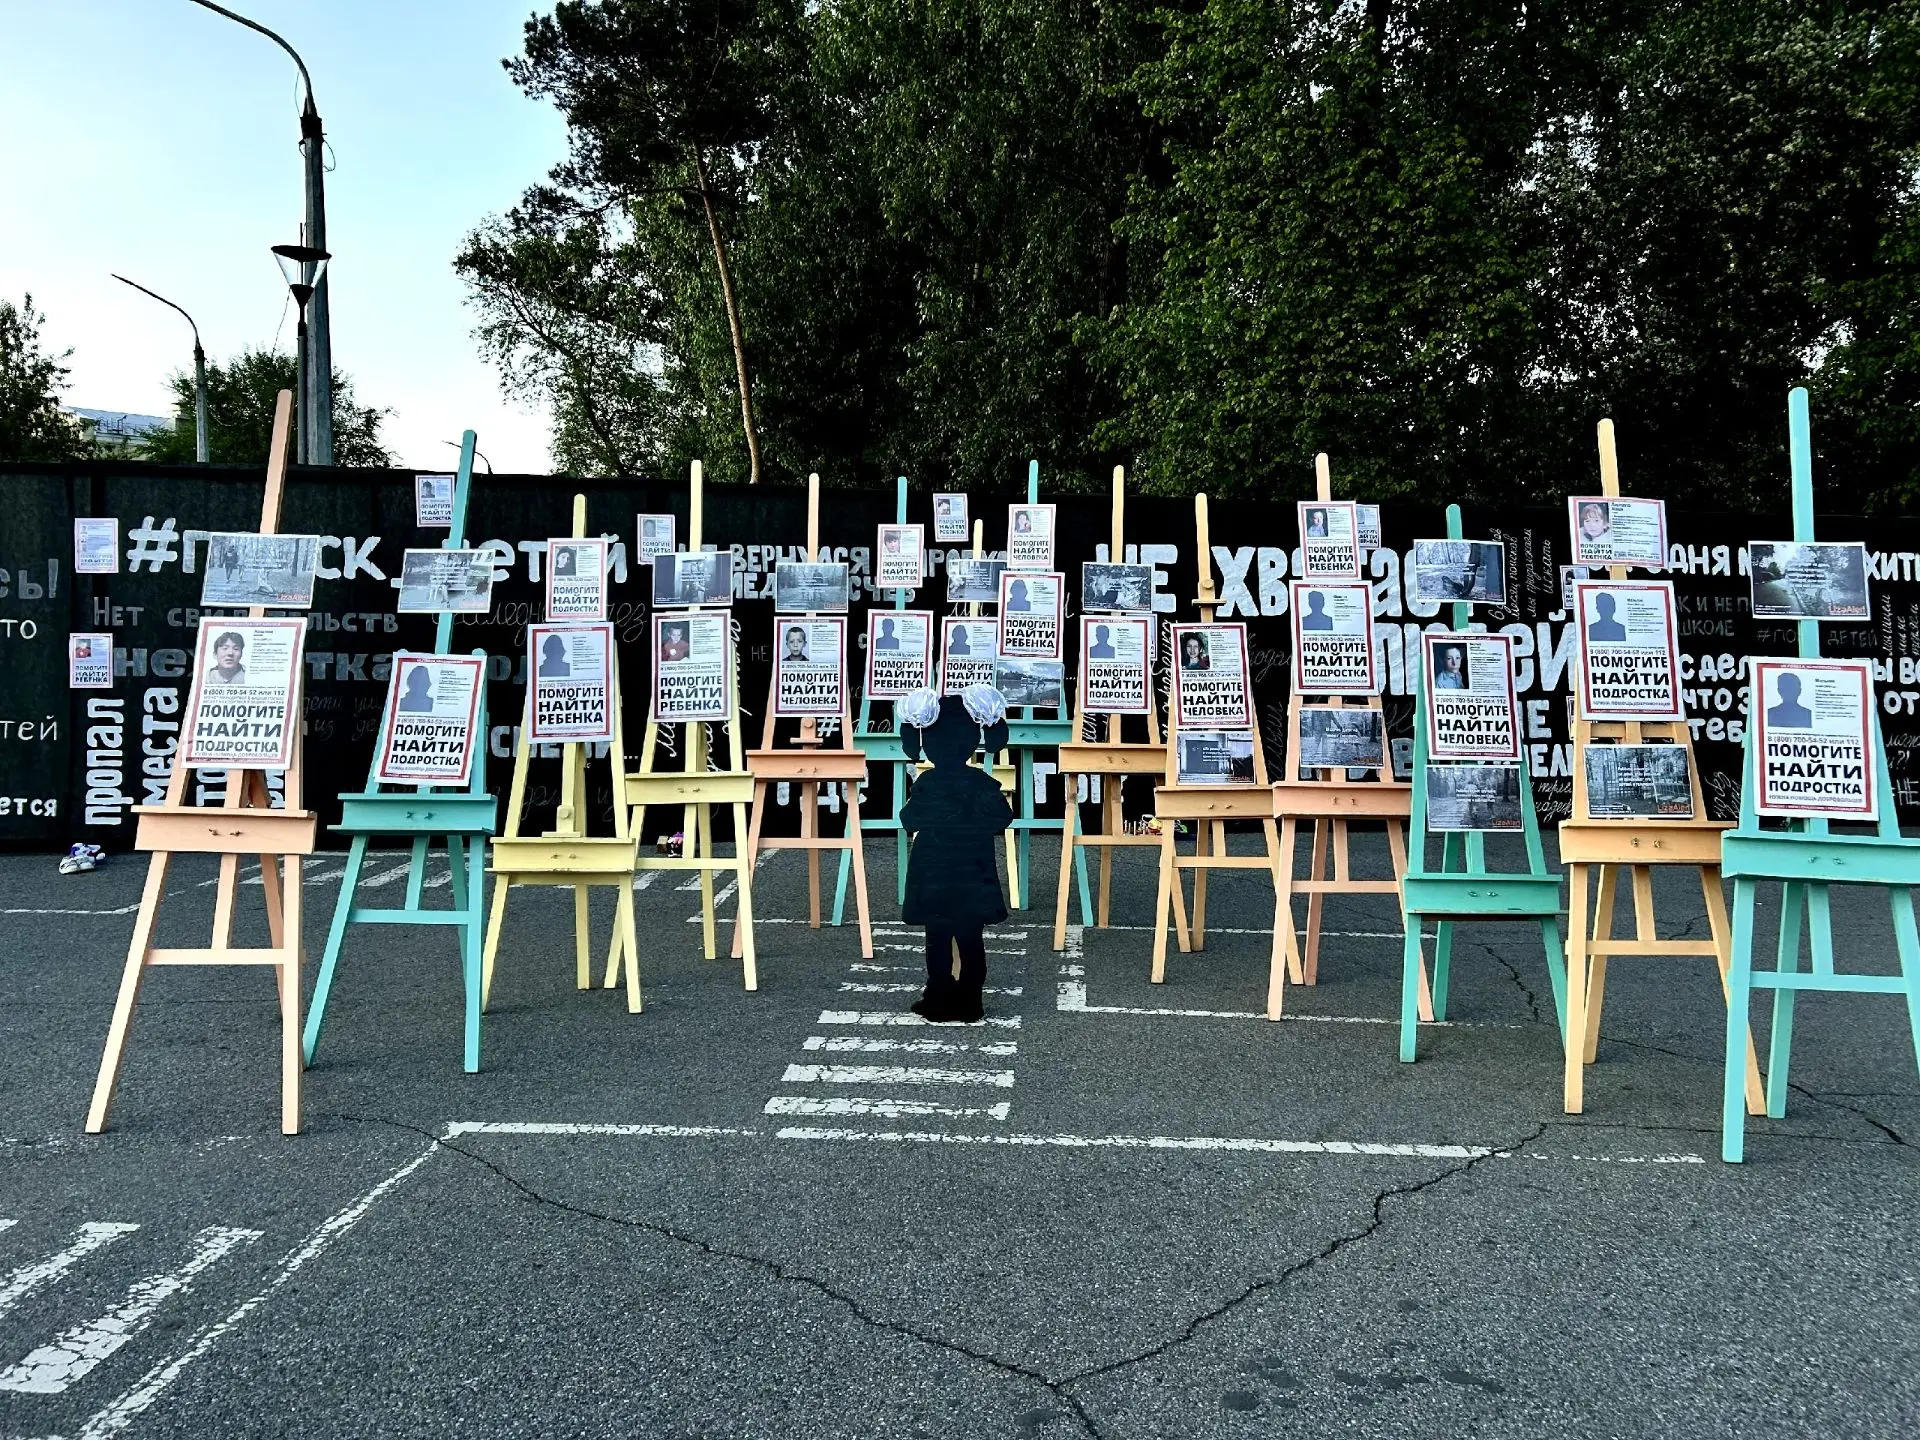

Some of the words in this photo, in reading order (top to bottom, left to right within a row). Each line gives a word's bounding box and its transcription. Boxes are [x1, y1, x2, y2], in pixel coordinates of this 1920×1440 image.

[1308, 546, 1353, 554] ПОМОГИТЕ
[1309, 553, 1354, 563] НАЙТИ
[883, 567, 918, 575] НАЙТИ
[1309, 563, 1354, 571] РЕБЕНКА
[553, 587, 600, 595] ПОМОГИТЕ
[553, 593, 600, 605] НАЙТИ
[1006, 619, 1056, 629] ПОМОГИТЕ
[1006, 628, 1055, 639] НАЙТИ
[1005, 638, 1055, 649] РЕБЕНКА
[1303, 642, 1367, 653] ПОМОГИТЕ
[874, 660, 924, 669] ПОМОГИТЕ
[1304, 652, 1367, 667] НАЙТИ
[1590, 656, 1668, 668] ПОМОГИТЕ
[946, 662, 994, 671] ПОМОГИТЕ
[781, 673, 839, 683] ПОМОГИТЕ
[874, 668, 924, 679] НАЙТИ
[946, 670, 993, 680] НАЙТИ
[1089, 668, 1143, 678] ПОМОГИТЕ
[1304, 668, 1367, 678] ПОДРОСТКА
[1591, 668, 1670, 686] НАЙТИ
[660, 676, 723, 687] ПОМОГИТЕ
[873, 679, 923, 689] РЕБЕНКА
[1089, 677, 1143, 690] НАЙТИ
[1182, 681, 1243, 692] ПОМОГИТЕ
[539, 687, 604, 699] ПОМОГИТЕ
[660, 686, 723, 700] НАЙТИ
[781, 682, 839, 695] НАЙТИ
[1089, 690, 1143, 699] ПОДРОСТКА
[1592, 688, 1670, 699] ПОДРОСТКА
[539, 698, 604, 712] НАЙТИ
[781, 696, 838, 705] ЧЕЛОВЕКА
[1183, 692, 1244, 706] НАЙТИ
[200, 704, 284, 719] ПОМОГИТЕ
[660, 700, 722, 712] РЕБЕНКА
[1184, 706, 1244, 716] ЧЕЛОВЕКА
[1436, 704, 1509, 717] ПОМОГИТЕ
[539, 712, 603, 726] РЕБЕНКА
[1437, 717, 1510, 733] НАЙТИ
[197, 719, 282, 737] НАЙТИ
[395, 724, 466, 737] ПОМОГИТЕ
[392, 737, 464, 753] НАЙТИ
[1438, 733, 1511, 746] ЧЕЛОВЕКА
[142, 687, 179, 806] места
[195, 740, 279, 753] ПОДРОСТКА
[1768, 743, 1862, 760] ПОМОГИТЕ
[85, 698, 134, 825] пропал
[390, 754, 461, 766] ПОДРОСТКА
[1768, 759, 1862, 780] НАЙТИ
[1768, 780, 1862, 795] ПОДРОСТКА
